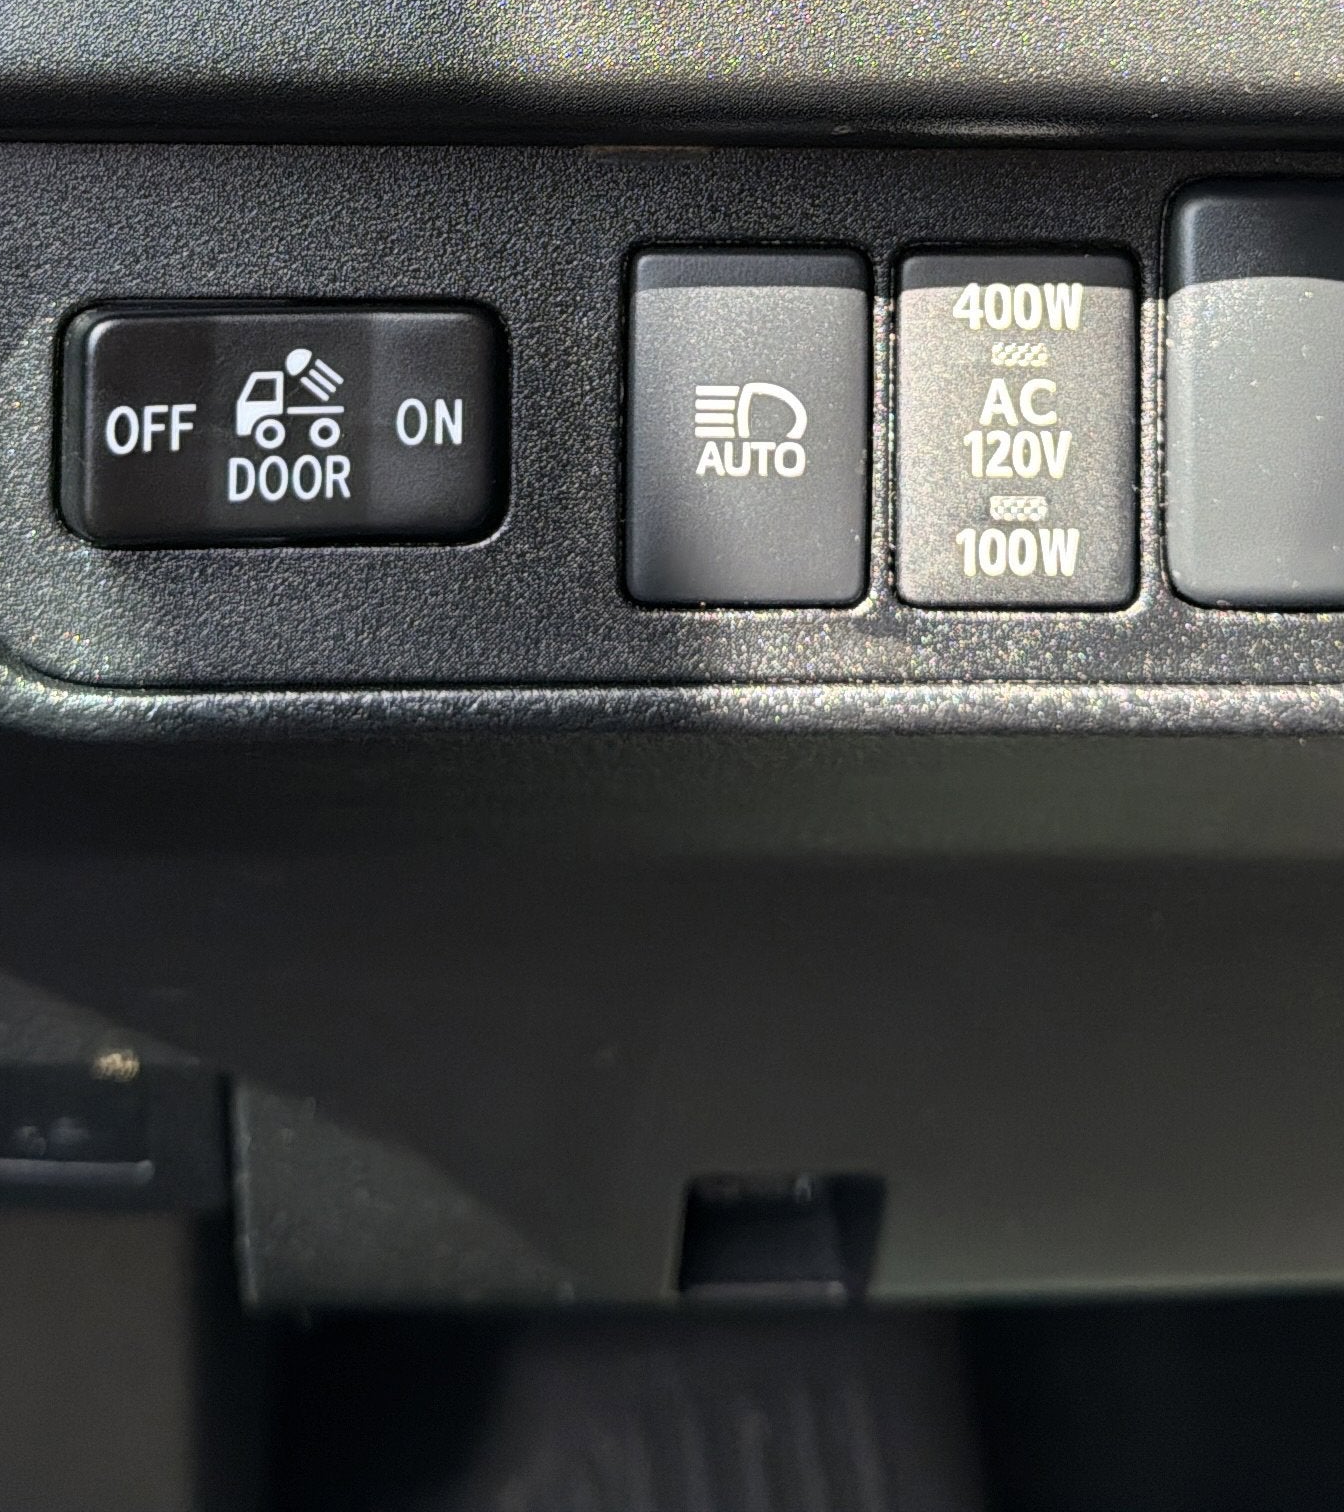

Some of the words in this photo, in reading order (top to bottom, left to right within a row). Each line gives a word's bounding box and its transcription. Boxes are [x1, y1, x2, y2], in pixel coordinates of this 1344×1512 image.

[951, 281, 1085, 332] 400W
[395, 397, 464, 448] ON
[978, 377, 1059, 427] AC
[104, 402, 198, 456] OFF
[962, 429, 1074, 479] 120V
[226, 453, 352, 503] DOOR
[694, 440, 807, 478] AUTO
[955, 527, 1081, 578] 100W
